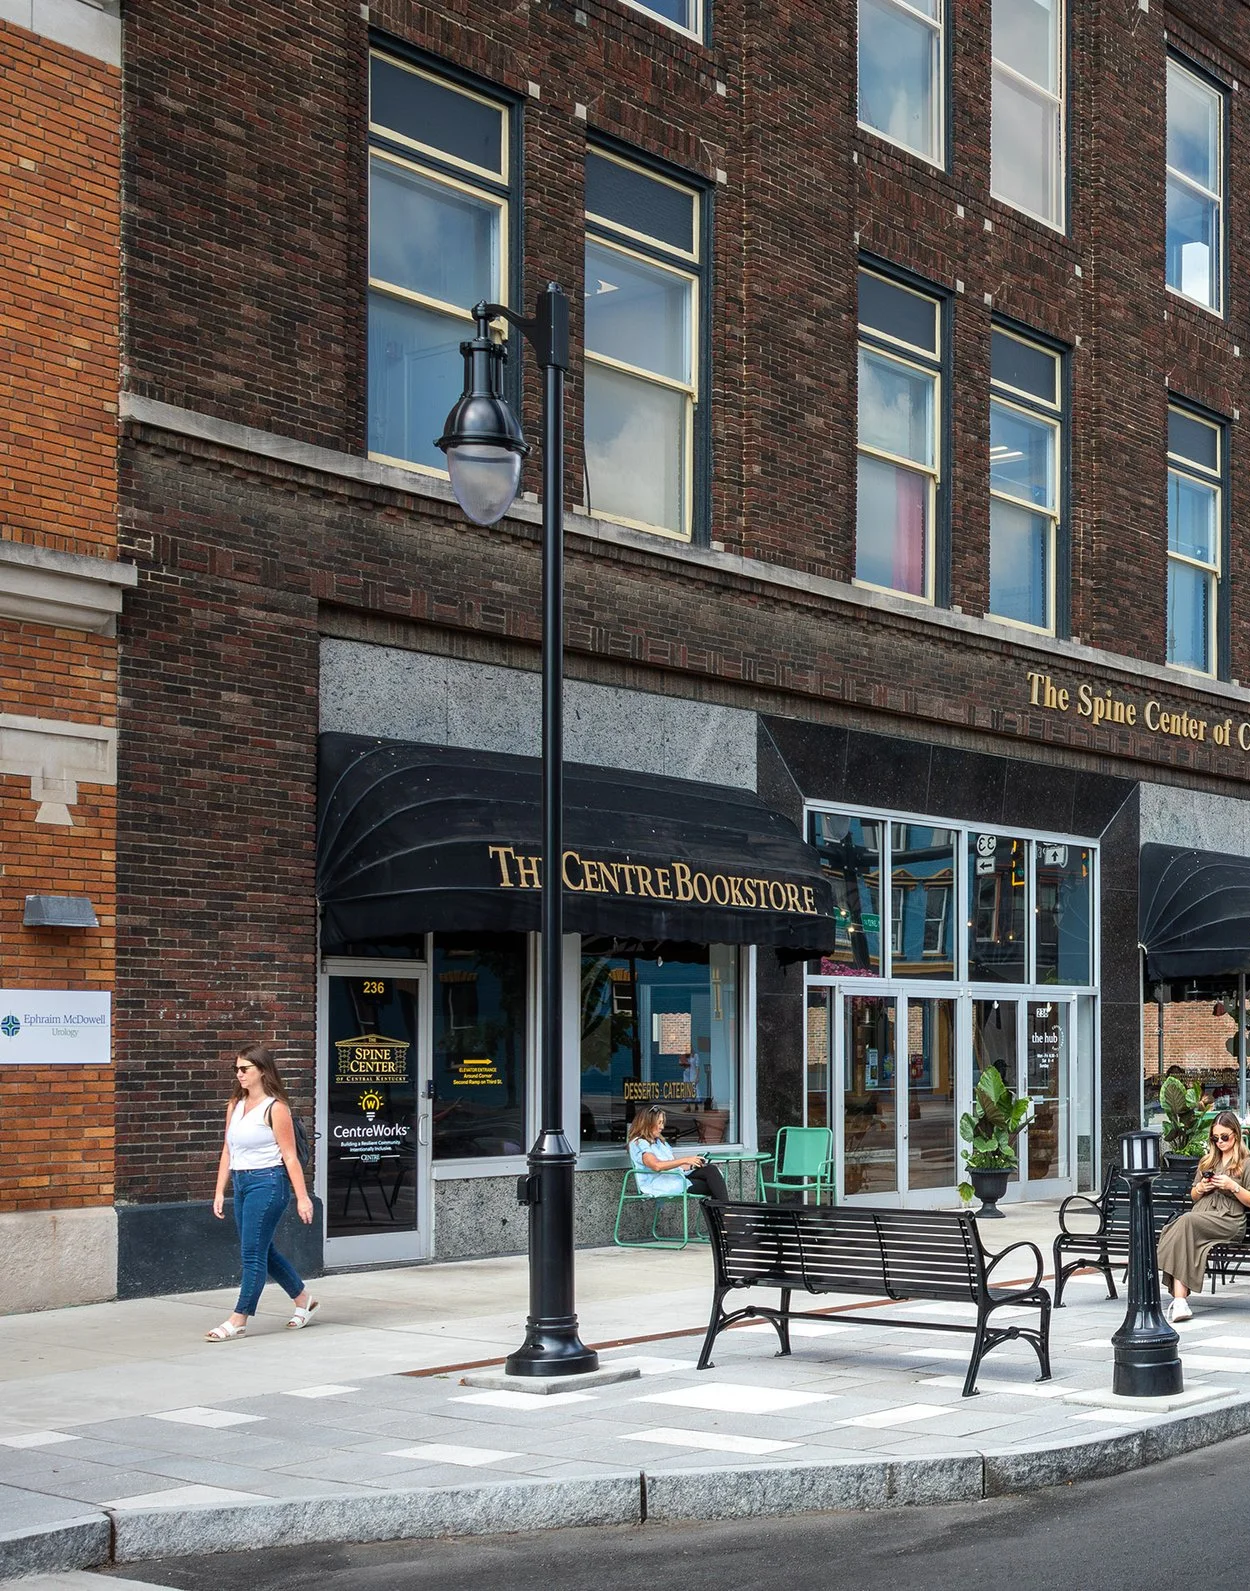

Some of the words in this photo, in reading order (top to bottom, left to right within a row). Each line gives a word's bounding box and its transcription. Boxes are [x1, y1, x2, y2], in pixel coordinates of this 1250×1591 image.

[1027, 672, 1069, 711] The
[1077, 684, 1136, 725] Spine
[1143, 701, 1207, 741] Center
[1213, 718, 1232, 746] of
[489, 846, 542, 888] TH
[363, 981, 385, 994] 236
[24, 1014, 60, 1026] Ephraim
[63, 1014, 106, 1024] McDowell
[52, 1028, 78, 1037] Urology
[1032, 1032, 1043, 1043] the
[1044, 1032, 1058, 1043] hub
[355, 1047, 391, 1060] SPINE
[350, 1060, 396, 1073] CENTER
[624, 1082, 660, 1099] DESSERTS
[663, 1082, 697, 1099] CATERING
[366, 1100, 375, 1109] W
